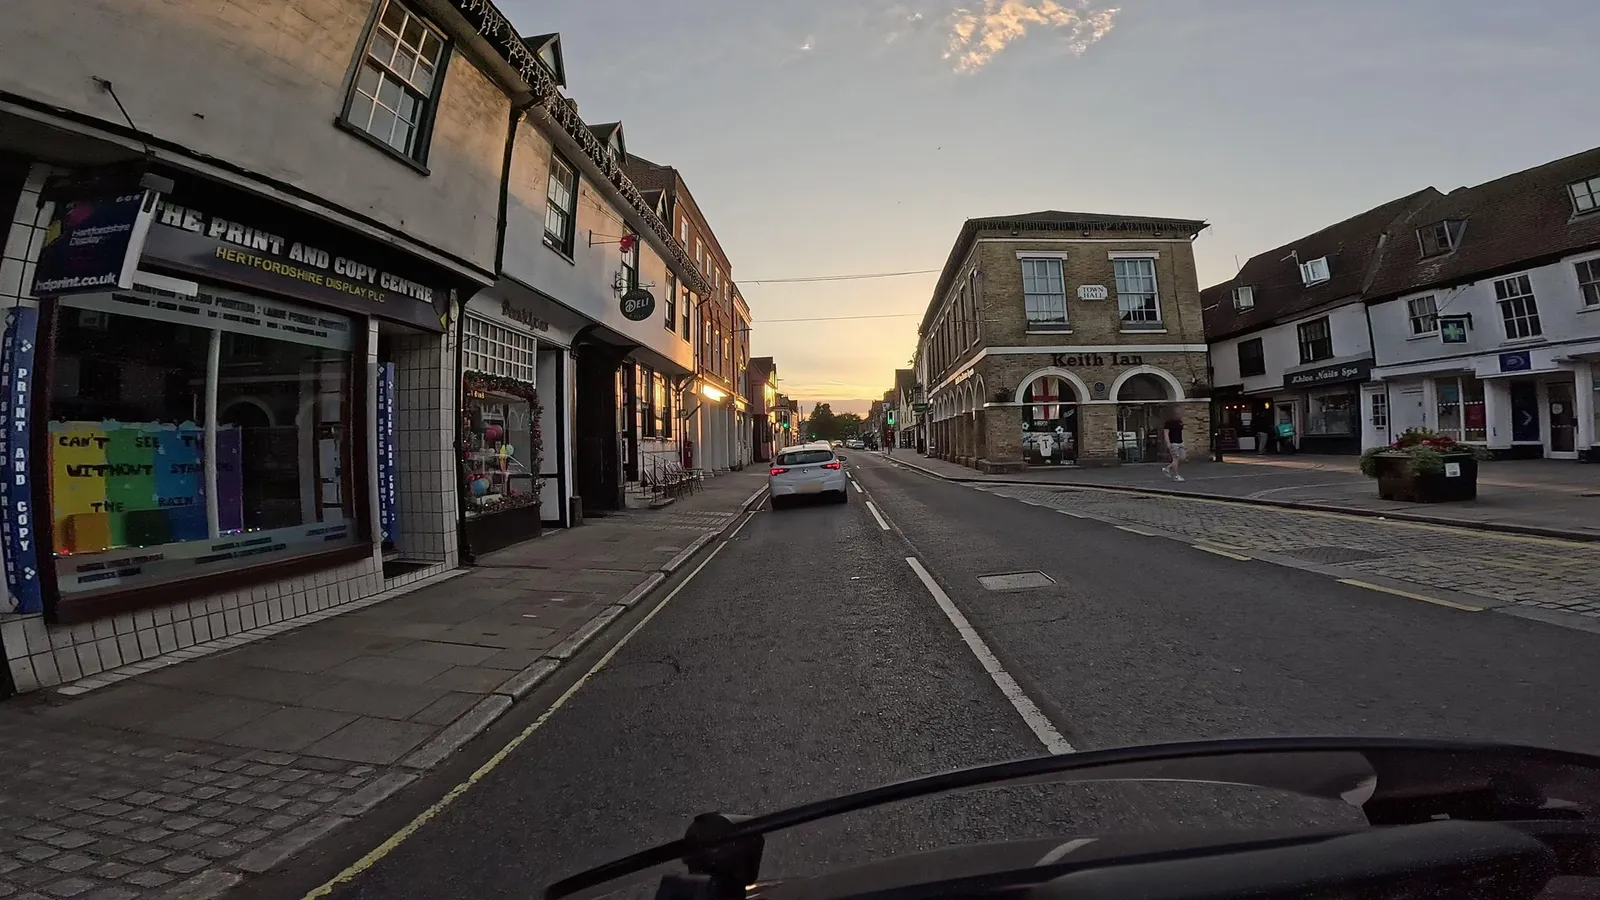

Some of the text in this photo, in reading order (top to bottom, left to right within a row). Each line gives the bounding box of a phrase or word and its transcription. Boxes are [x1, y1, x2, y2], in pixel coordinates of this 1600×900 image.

[208, 216, 284, 256] PRINT
[288, 242, 330, 270] AND
[334, 256, 377, 285] COPY
[380, 271, 433, 304] CENTRE
[216, 246, 386, 304] HERTFORDSHIRE DISPLAY PLC
[624, 296, 650, 313] DELI
[1052, 352, 1144, 367] Keith Ian
[1315, 369, 1339, 381] Nails
[1341, 367, 1359, 378] Spa
[58, 433, 110, 450] CAN'T
[134, 435, 160, 448] SEE
[14, 367, 30, 552] PRINT AND COPY
[66, 464, 153, 477] WITHOUT
[90, 501, 125, 513] THE
